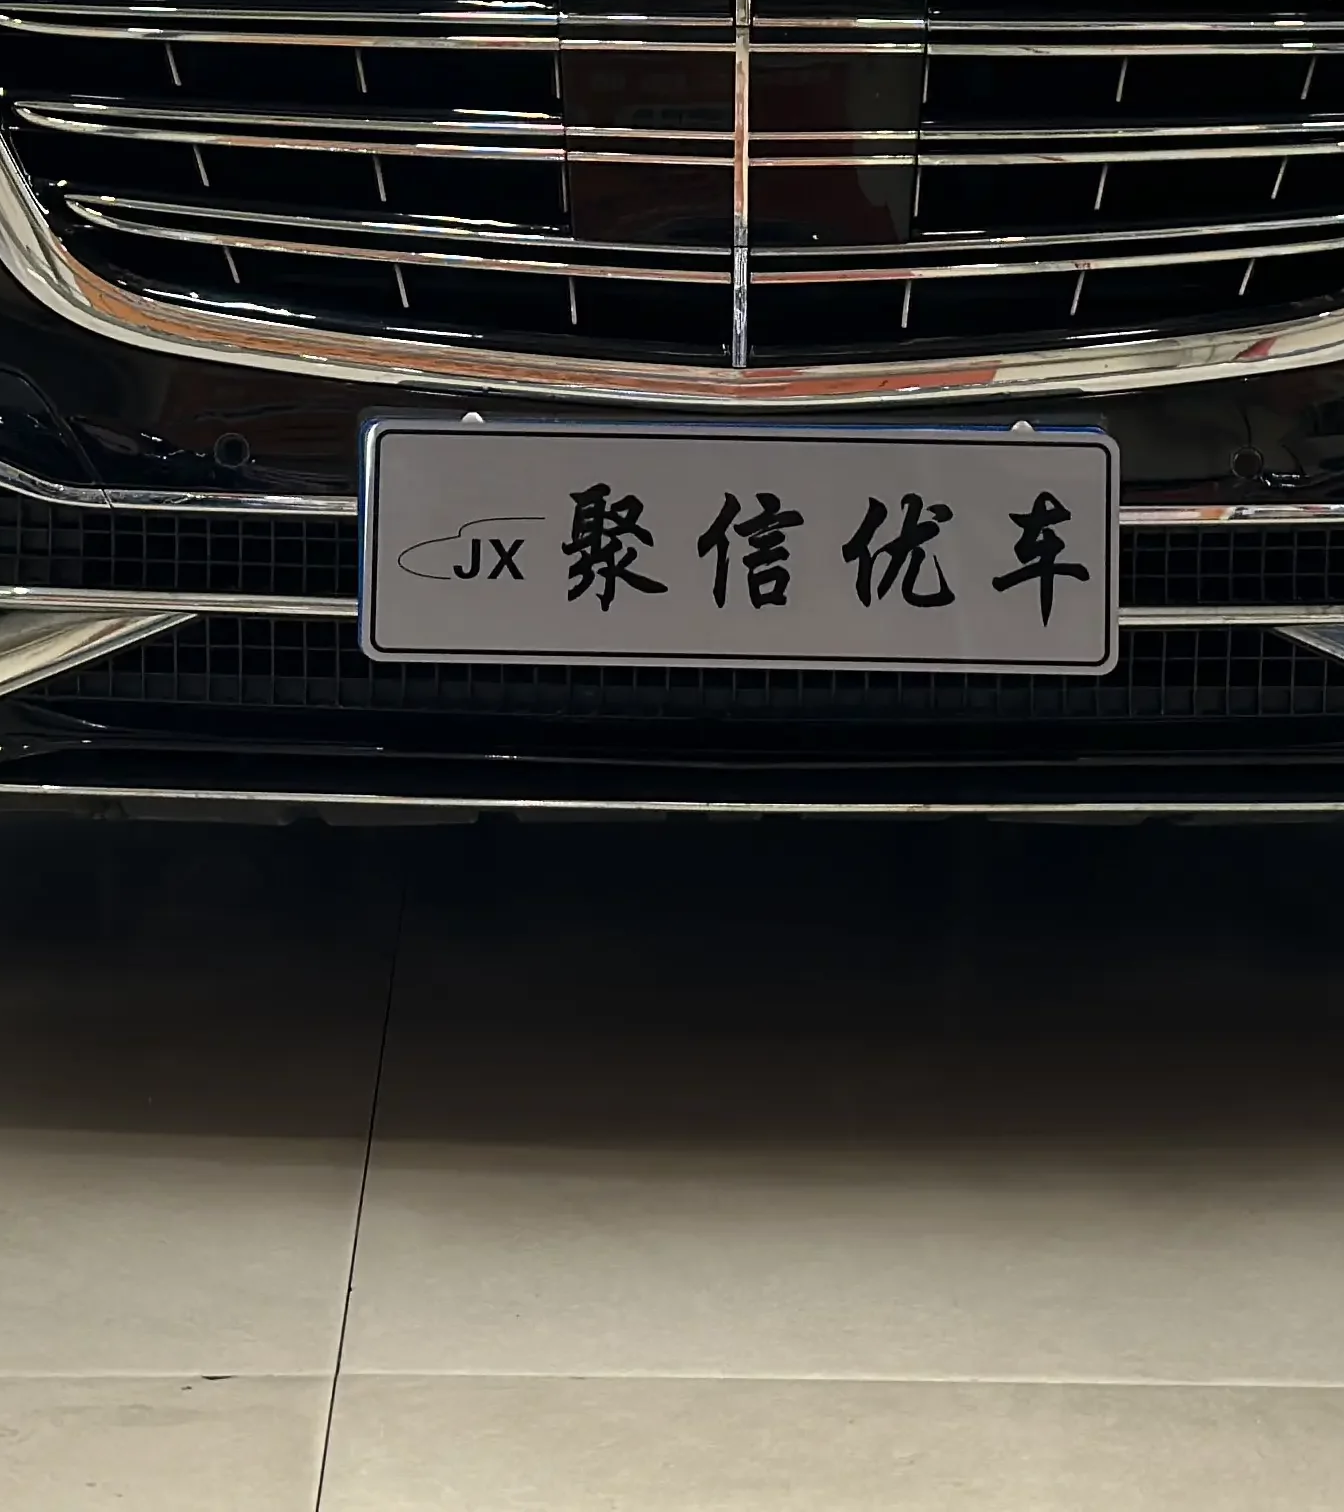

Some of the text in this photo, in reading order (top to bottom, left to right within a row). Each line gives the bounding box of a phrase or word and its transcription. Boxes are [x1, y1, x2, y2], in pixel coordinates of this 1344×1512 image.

[453, 482, 1092, 628] JX 聚信优车
